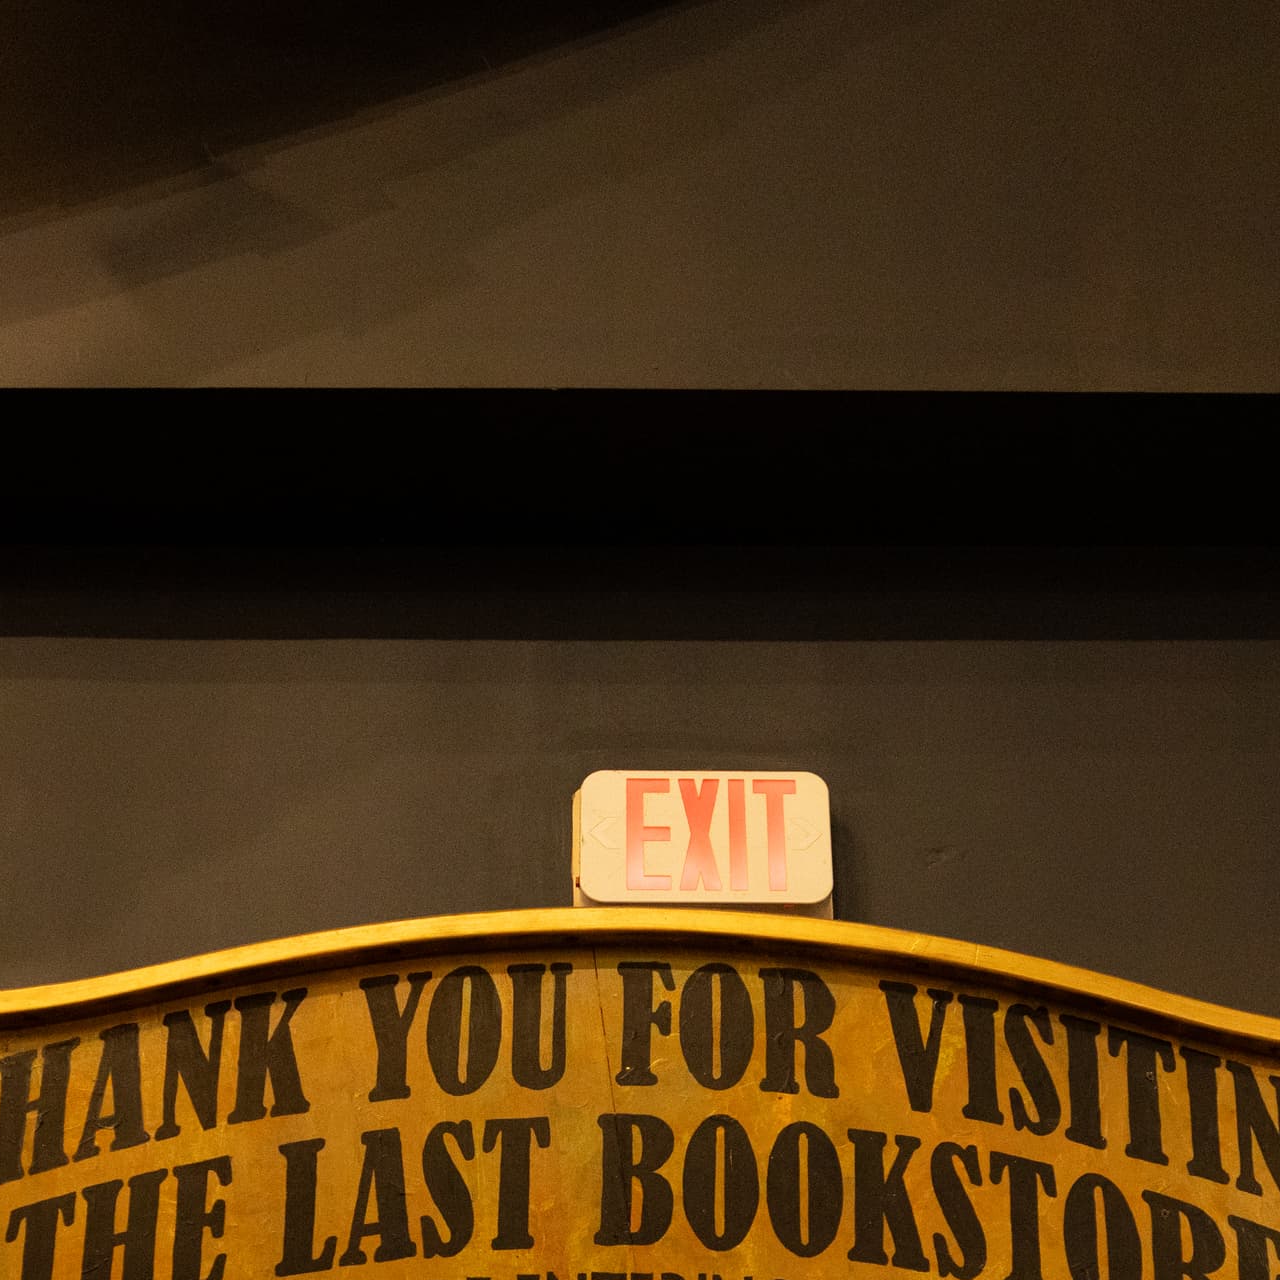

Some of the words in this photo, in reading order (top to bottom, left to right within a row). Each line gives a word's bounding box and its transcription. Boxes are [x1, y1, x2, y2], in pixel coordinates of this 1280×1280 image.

[625, 778, 797, 892] EXIT
[359, 962, 573, 1103] YOU
[616, 961, 841, 1100] FOR
[274, 1116, 552, 1278] LAST
